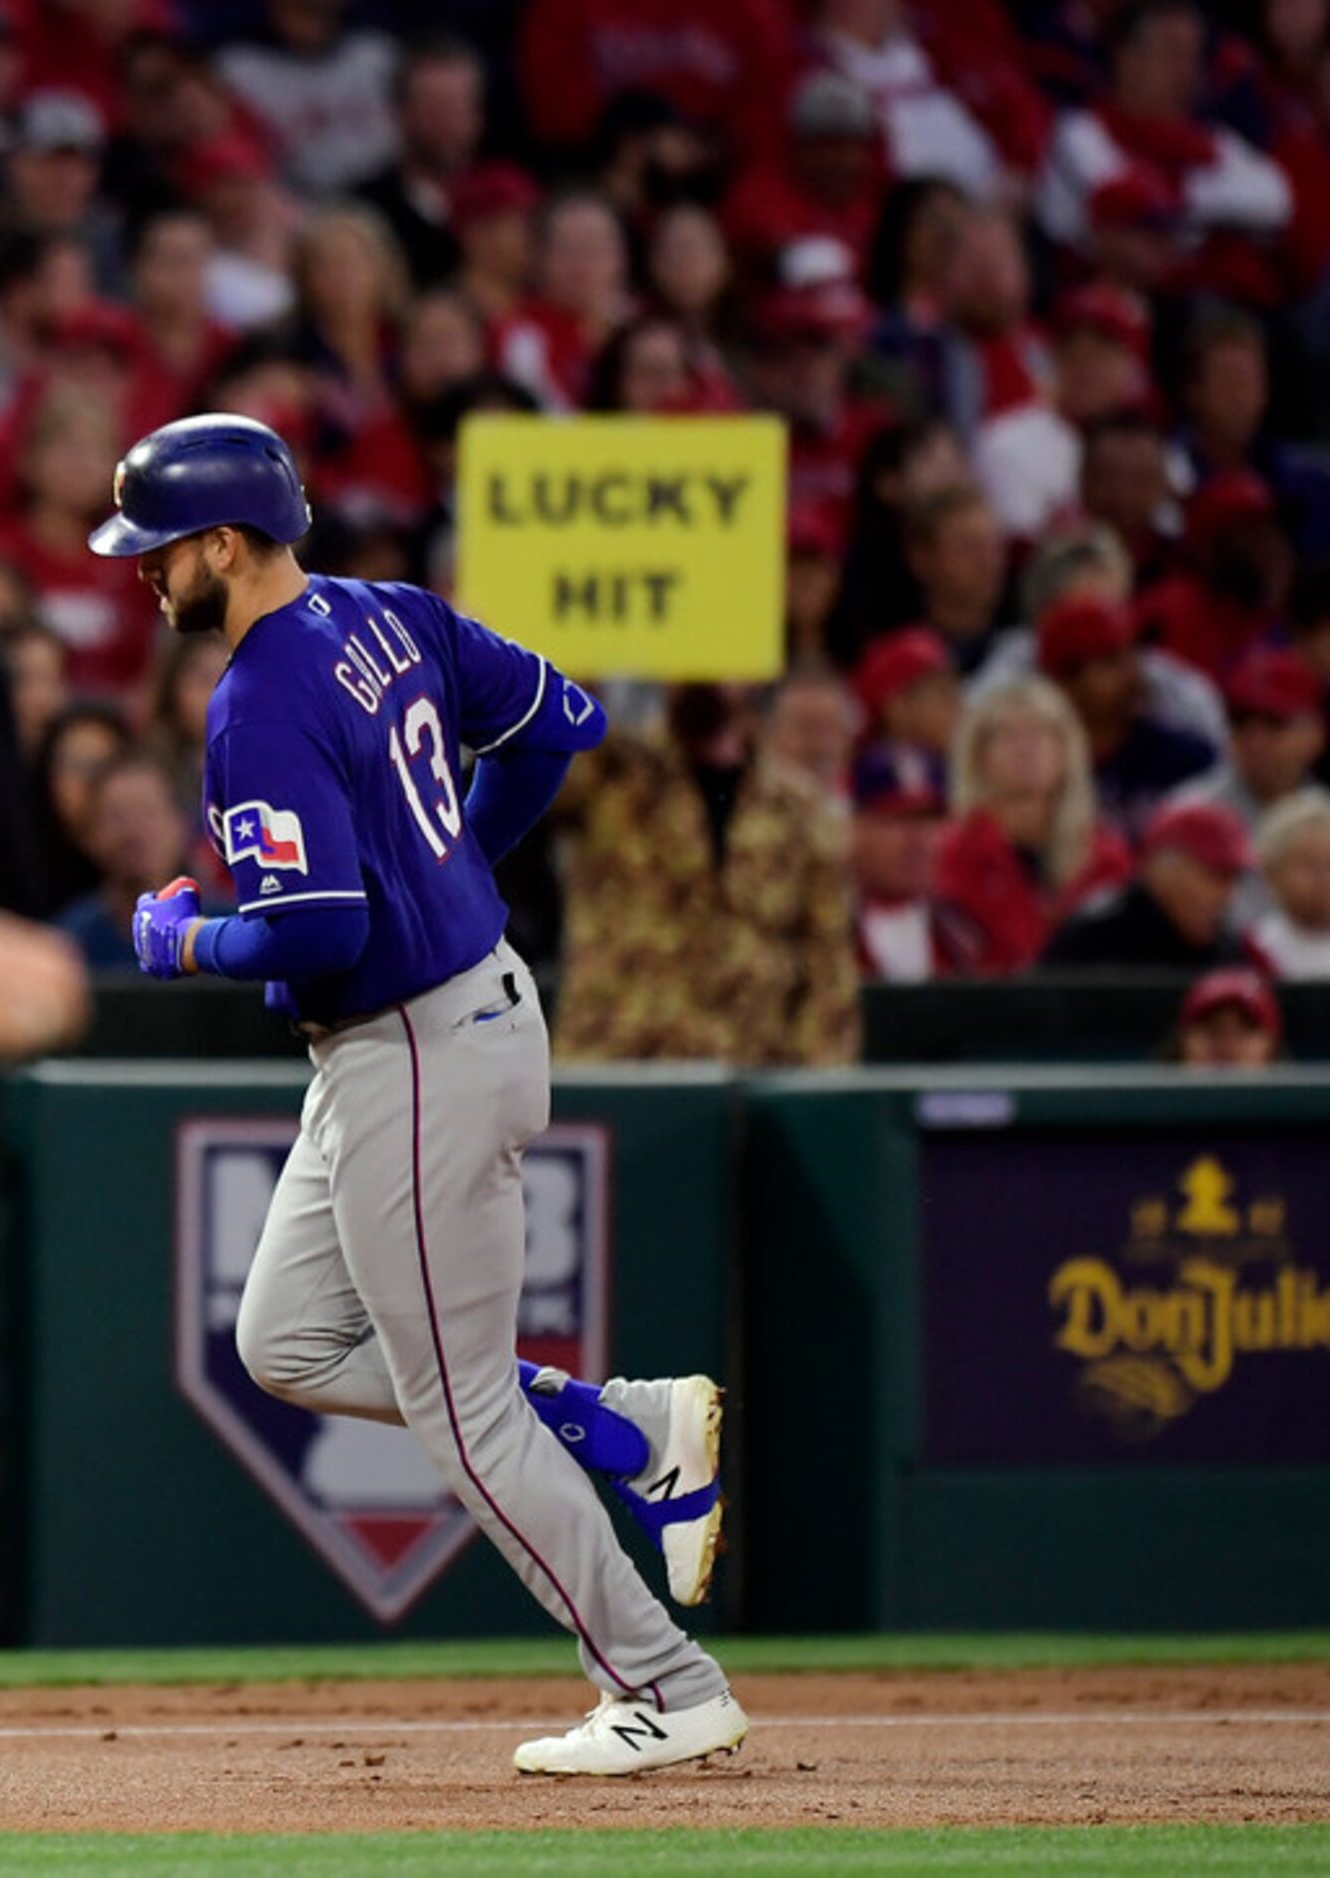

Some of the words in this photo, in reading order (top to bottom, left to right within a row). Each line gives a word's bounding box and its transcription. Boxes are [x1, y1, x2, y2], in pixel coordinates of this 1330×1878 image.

[487, 471, 749, 530] LUCKY
[552, 570, 680, 625] HIT
[389, 696, 461, 862] 13
